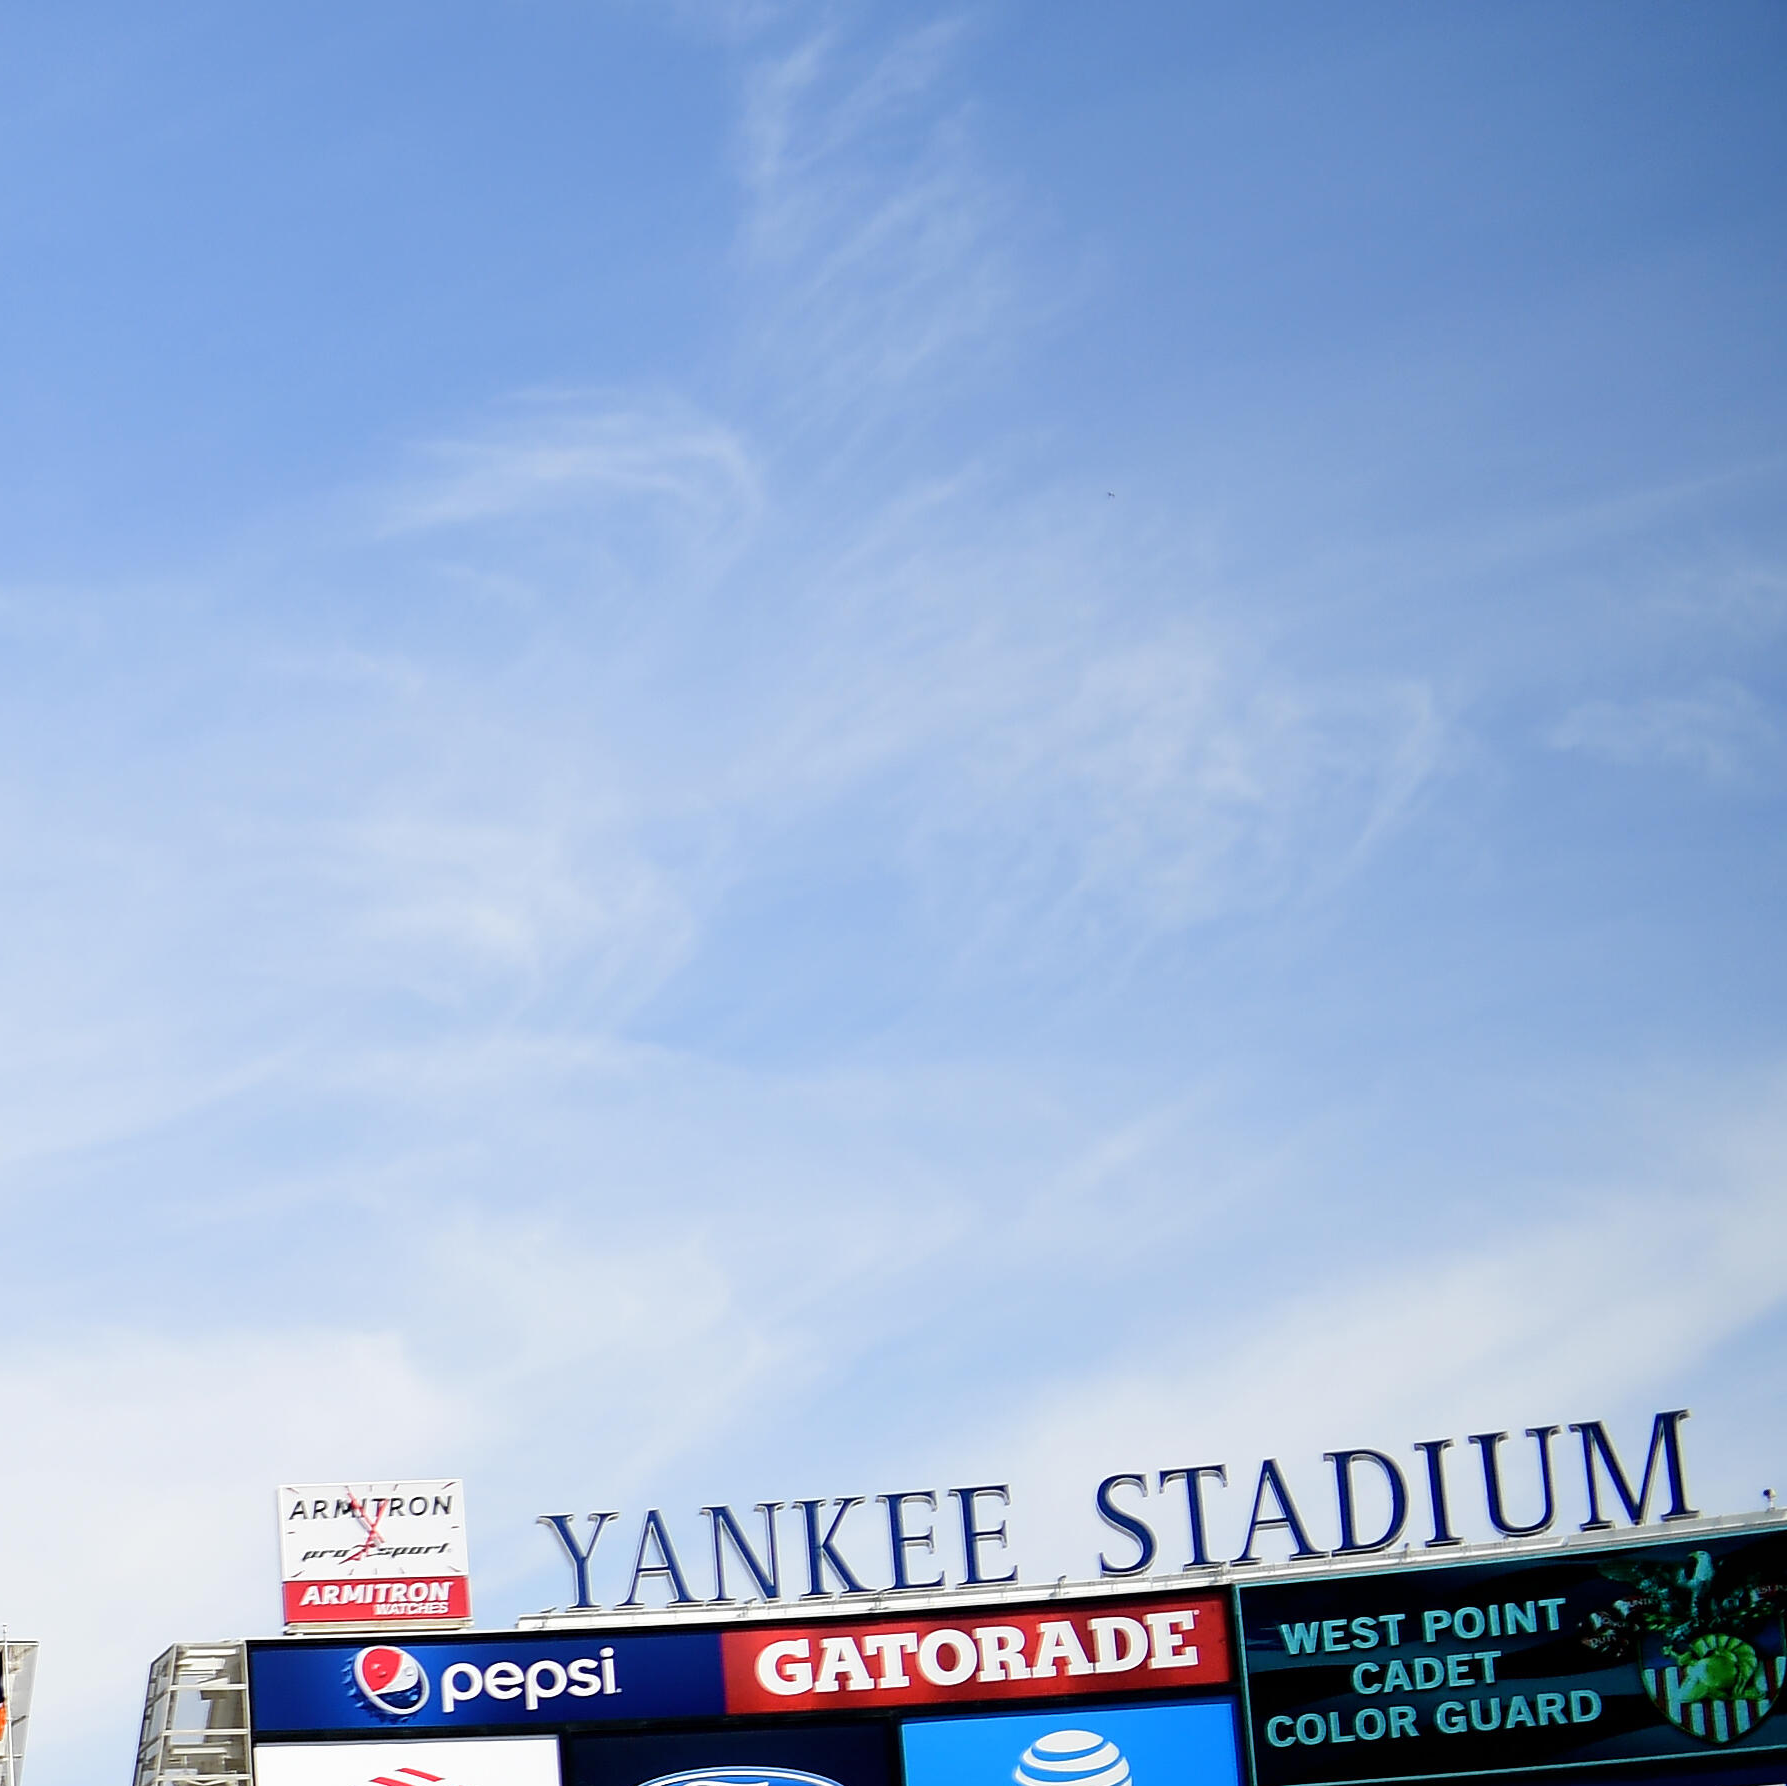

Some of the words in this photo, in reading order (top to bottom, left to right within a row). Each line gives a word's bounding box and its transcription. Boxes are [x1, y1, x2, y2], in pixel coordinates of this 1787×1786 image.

[289, 1495, 453, 1521] ARMITRON
[537, 1483, 1021, 1612] YANKEE
[1096, 1408, 1702, 1578] STADIUM
[300, 1582, 451, 1606] ARMITRON
[373, 1602, 449, 1615] WATCHES
[755, 1609, 1200, 1697] GATORADE
[1280, 1613, 1404, 1656] WEST
[1425, 1596, 1568, 1644] POINT
[441, 1647, 618, 1713] pepsi
[1352, 1650, 1502, 1695] CADET
[1266, 1705, 1420, 1748] COLOR
[1433, 1689, 1602, 1735] GUARD
